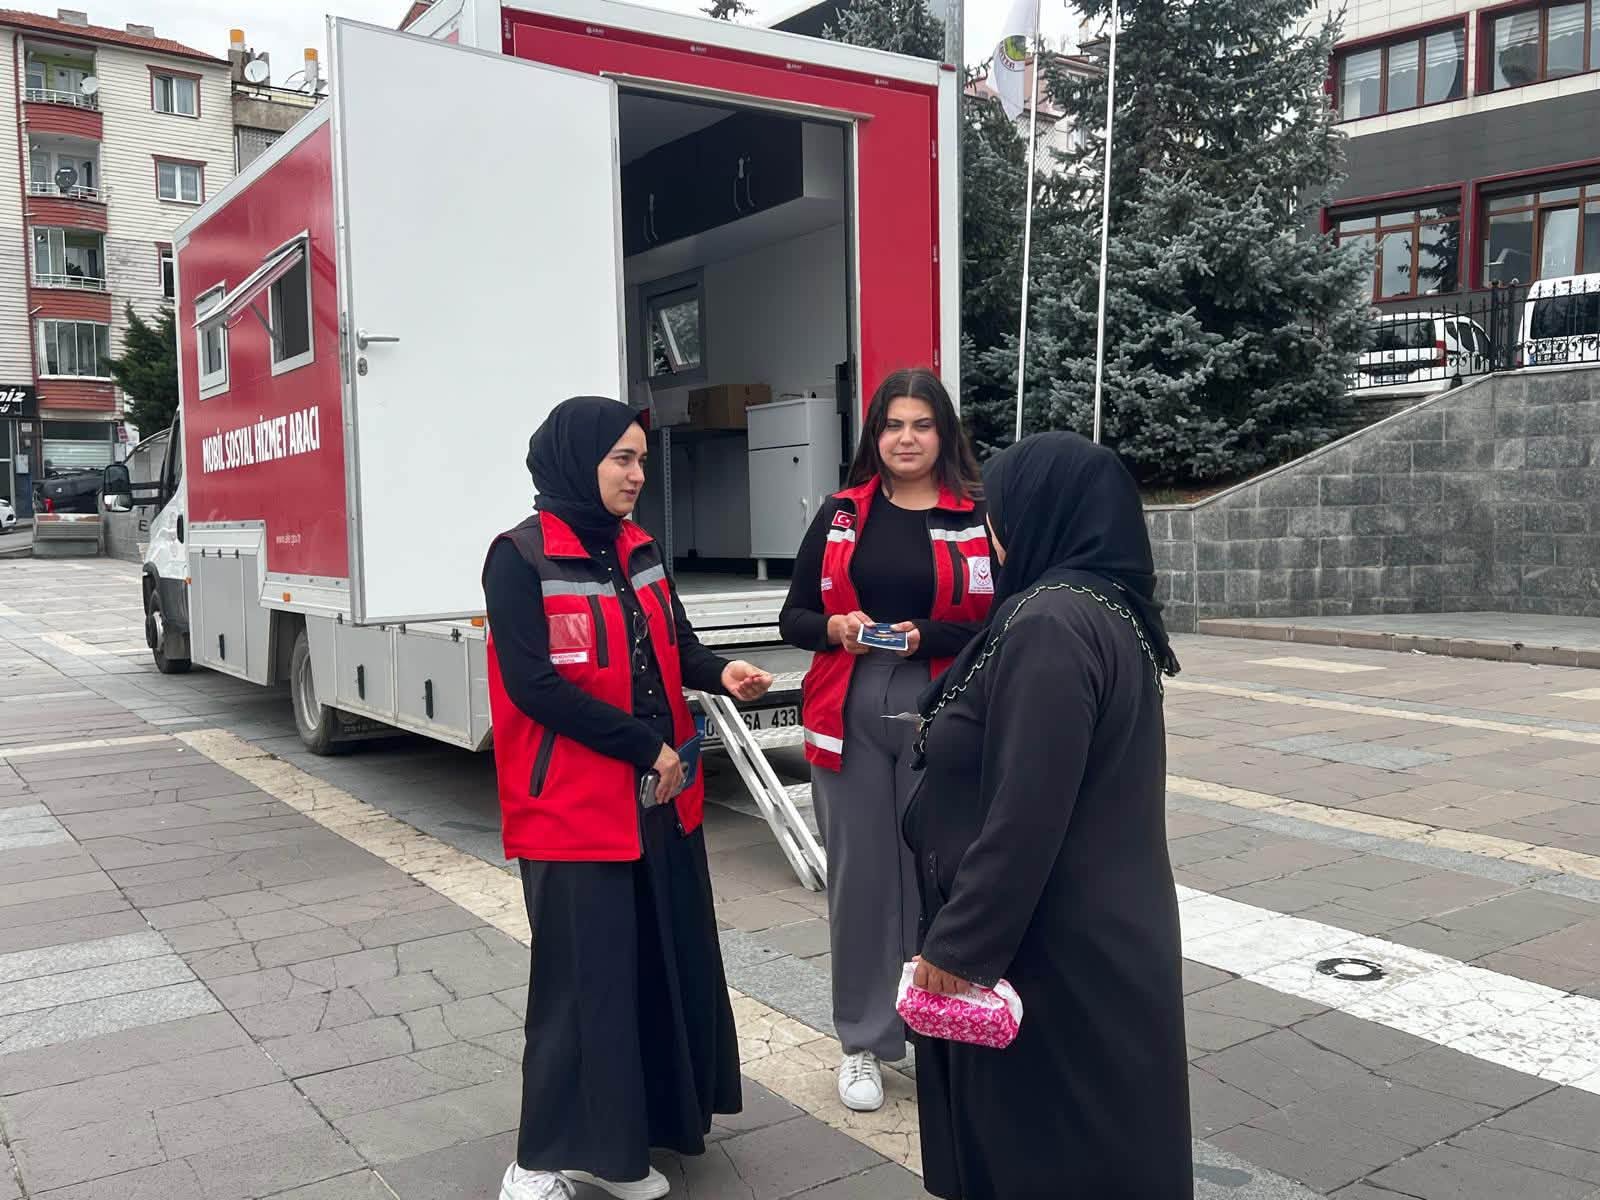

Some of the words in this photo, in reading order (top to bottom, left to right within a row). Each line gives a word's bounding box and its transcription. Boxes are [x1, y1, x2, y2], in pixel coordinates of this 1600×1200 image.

[202, 427, 225, 474] MOBİL
[225, 426, 254, 469] SOSYAL
[254, 414, 287, 463] HİZMET
[289, 406, 320, 456] ARACI
[771, 708, 797, 728] 433
